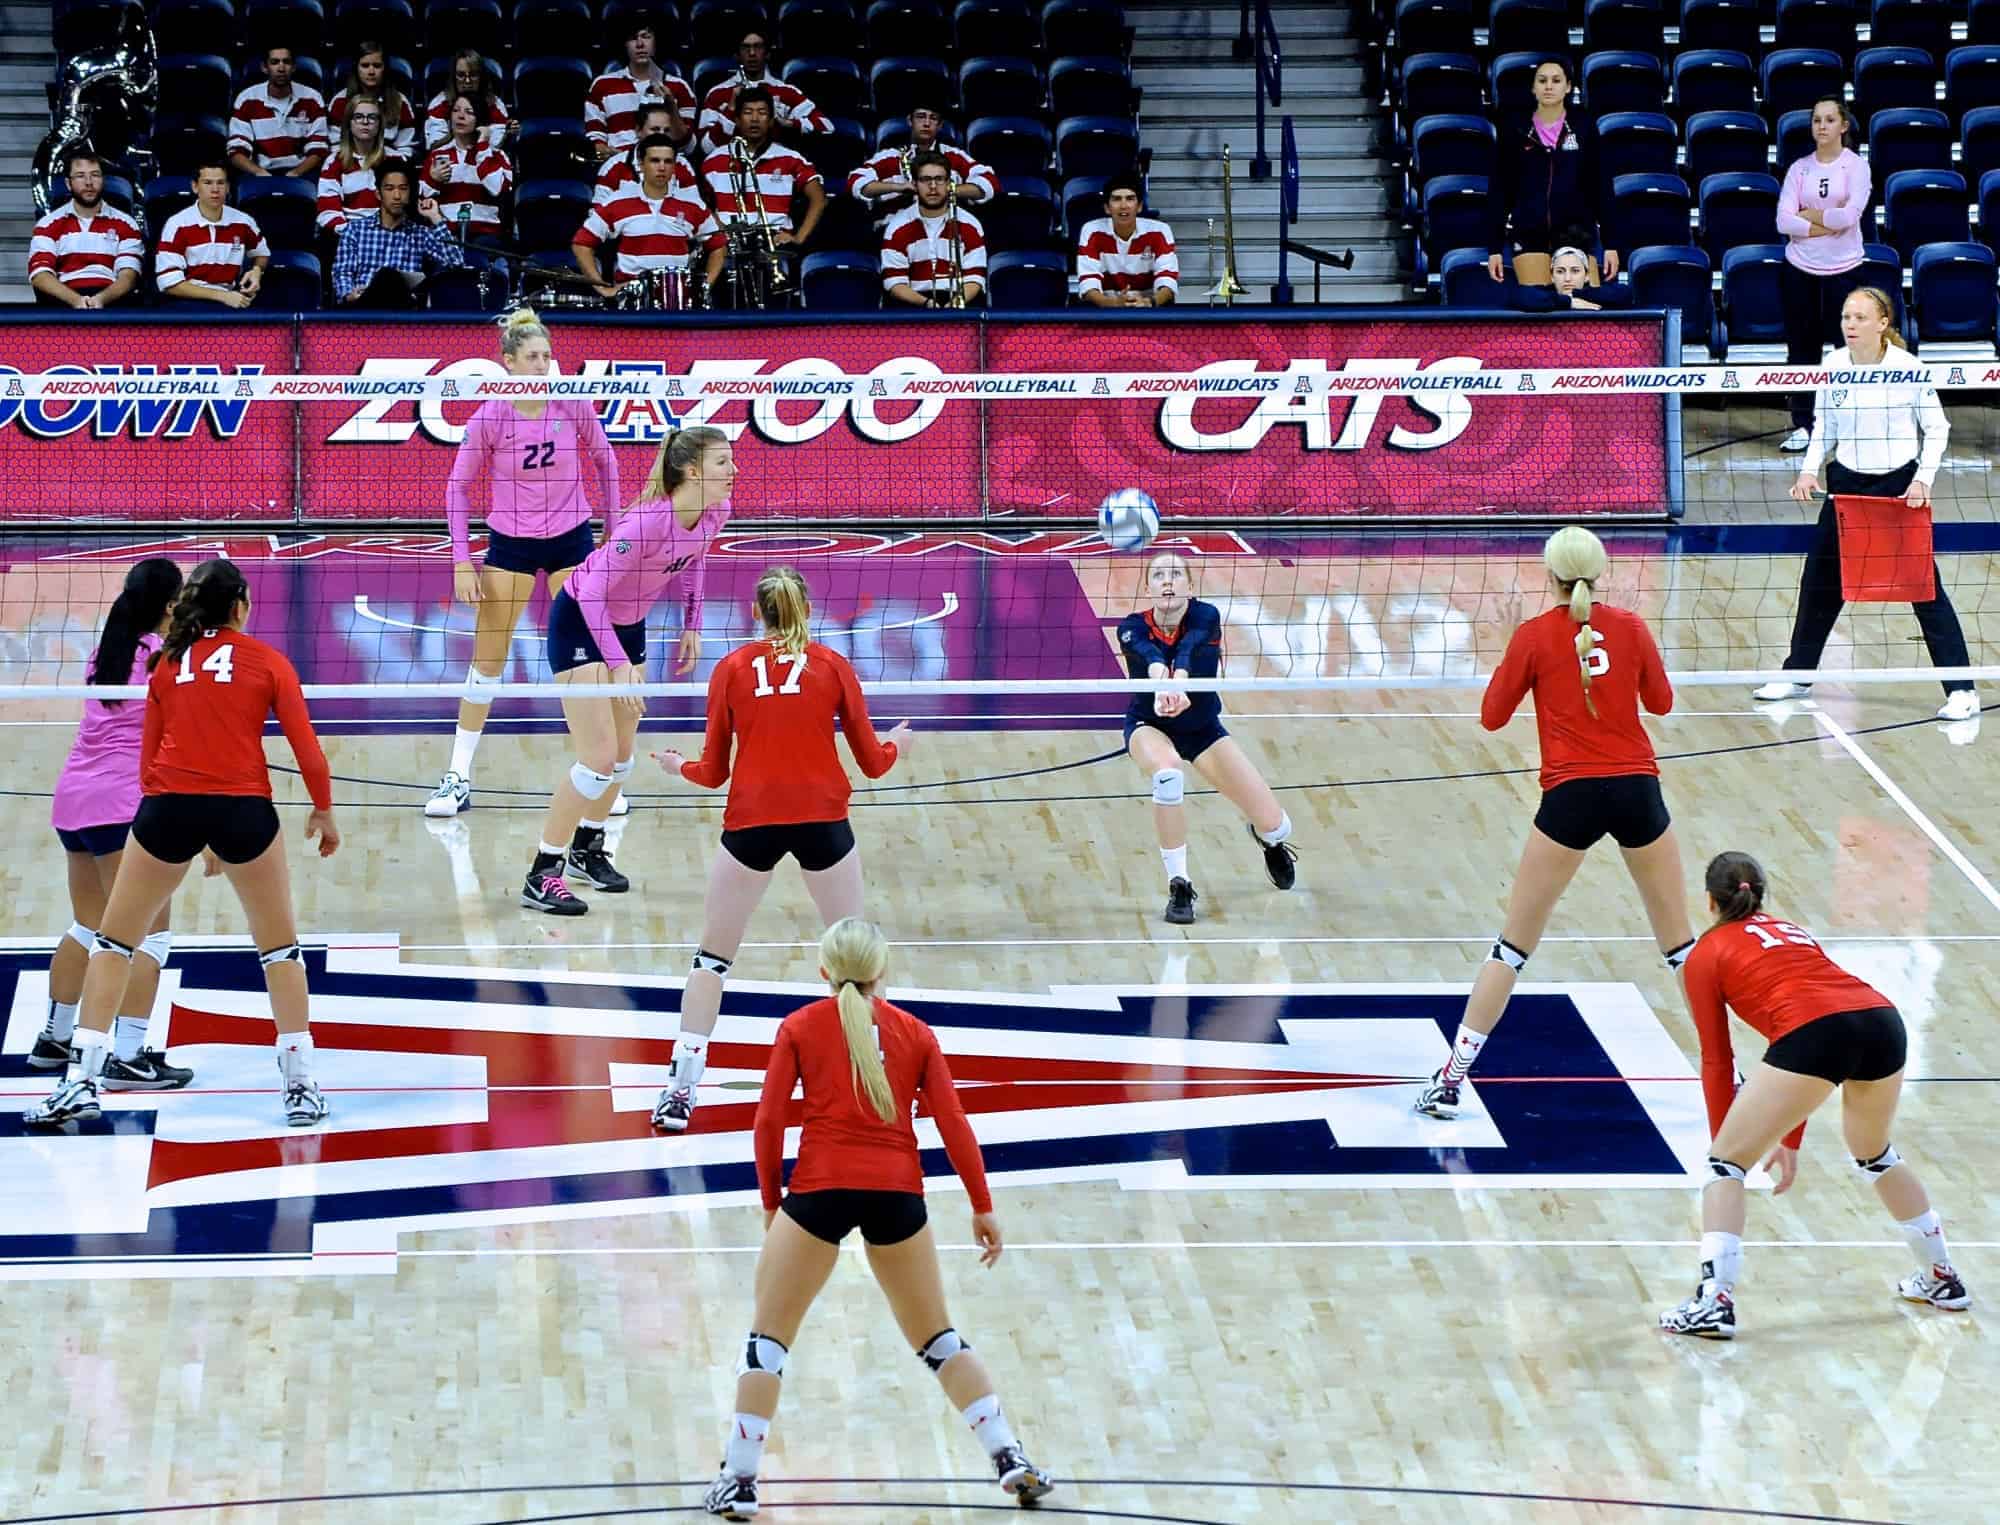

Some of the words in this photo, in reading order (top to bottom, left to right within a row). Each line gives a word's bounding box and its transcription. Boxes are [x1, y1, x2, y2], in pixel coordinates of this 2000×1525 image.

[1819, 178, 1829, 199] 5
[0, 365, 264, 437] OWN
[6, 379, 24, 396] A
[41, 381, 220, 395] ARIZONAVOLLEYBALL
[235, 379, 253, 396] A
[269, 381, 425, 395] ARIZONAWILDCATS
[441, 379, 459, 397] A
[475, 381, 651, 395] ARIZONAVOLLEYBALL
[666, 379, 684, 396] A
[700, 381, 853, 395] ARIZONAWILDCATS
[869, 379, 887, 396] A
[903, 379, 1077, 394] ARIZONAVOLLEYBALL
[1092, 377, 1110, 394] A
[1126, 378, 1280, 392] ARIZONAWILDCATS
[1294, 376, 1312, 393] A
[1328, 375, 1503, 391] ARIZONAVOLLEYBALL
[1517, 374, 1536, 391] A
[1552, 373, 1706, 388] ARIZONAWILDCATS
[1721, 371, 1739, 388] A
[1755, 369, 1932, 386] ARIZONAVOLLEYBALL
[1947, 367, 1966, 385] A
[1161, 357, 1483, 450] CATS
[523, 441, 556, 470] 22
[175, 643, 234, 685] 14
[1574, 629, 1610, 676] 6
[751, 652, 808, 698] 17
